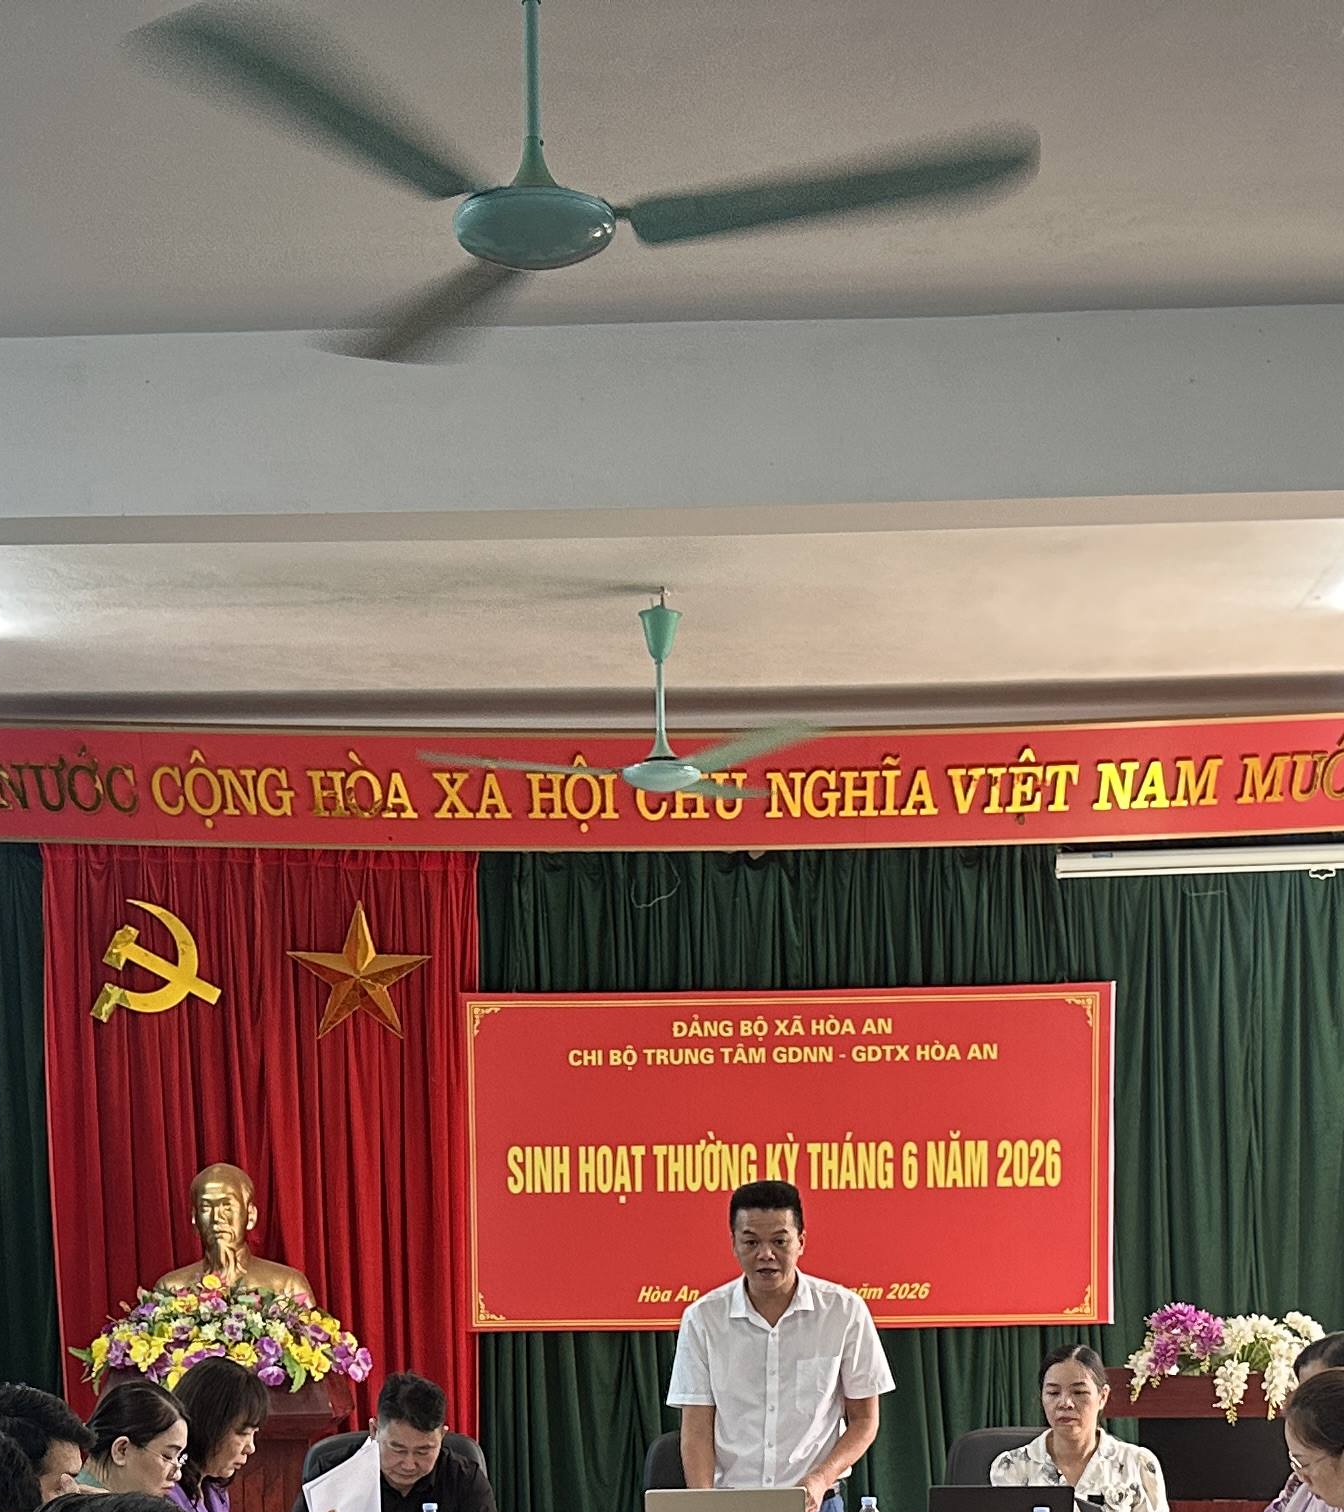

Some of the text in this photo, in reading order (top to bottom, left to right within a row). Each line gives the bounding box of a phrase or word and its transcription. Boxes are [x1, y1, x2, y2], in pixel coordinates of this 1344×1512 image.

[151, 749, 295, 829] CỘNG
[307, 751, 418, 819] HÒA
[526, 754, 619, 833] HỘI
[765, 754, 938, 819] NGHĨA
[946, 746, 1080, 825] VIỆT
[1092, 757, 1224, 810] NAM
[672, 1014, 892, 1041] ĐẢNG BỘ XÃ HÒA AN
[568, 1049, 603, 1066] CHI
[609, 1045, 638, 1071] BỘ
[643, 1048, 714, 1065] TRUNG
[720, 1043, 766, 1064] TÂM
[772, 1046, 833, 1063] GDNN
[851, 1045, 910, 1062] GDTX
[916, 1040, 961, 1061] HÒA
[967, 1043, 998, 1060] AN
[507, 1130, 1061, 1204] SINH HOẠT THƯỜNG KỲ THÁNG 6 NĂM 2026
[637, 1282, 931, 1302] Hòa An ăm 2026
